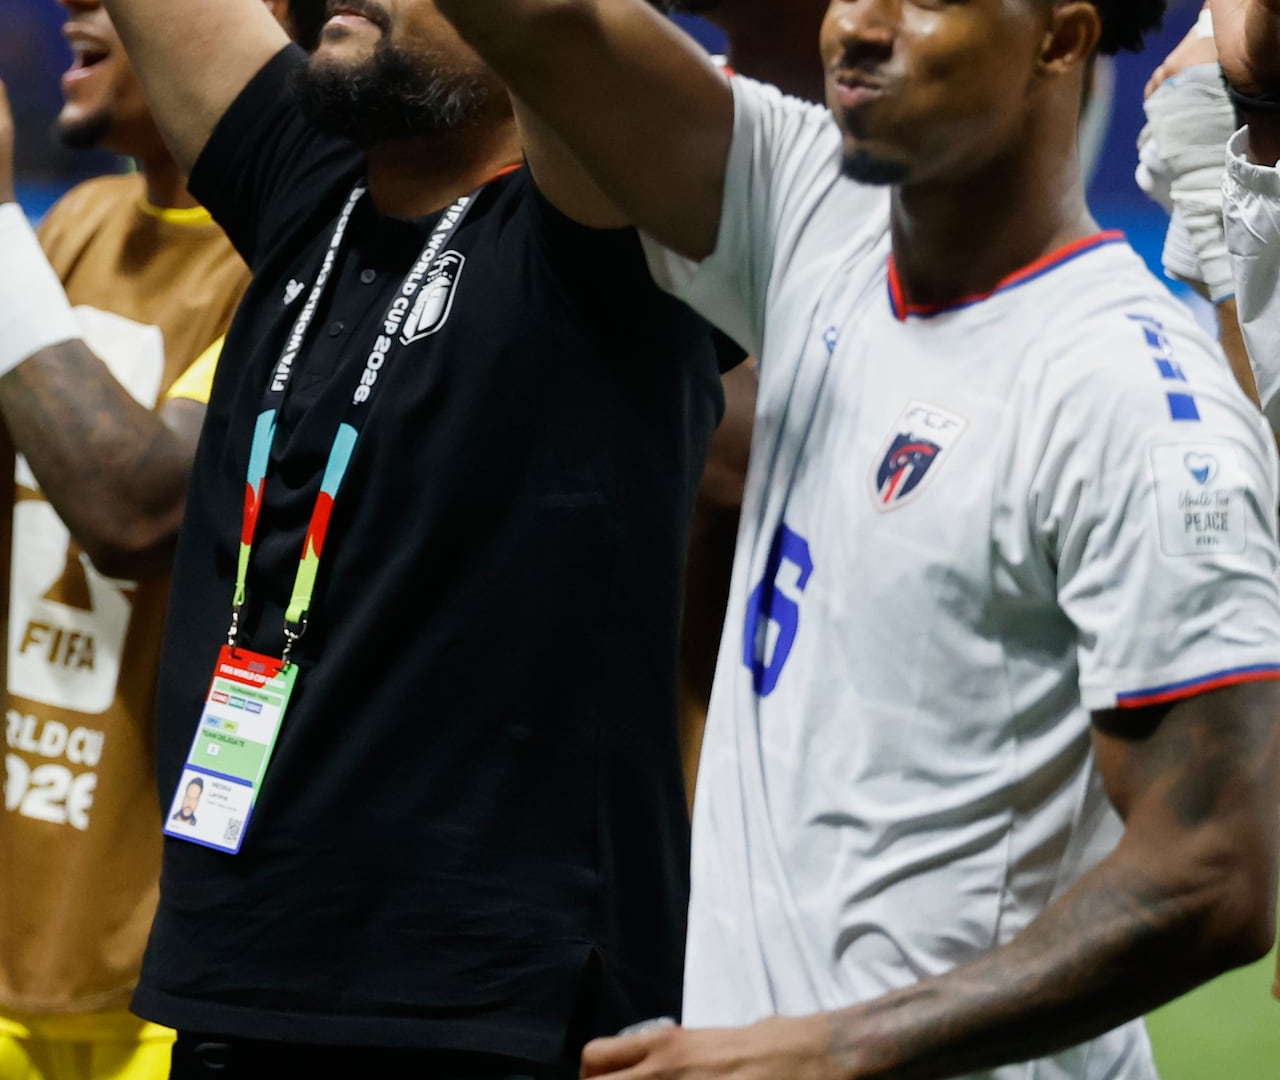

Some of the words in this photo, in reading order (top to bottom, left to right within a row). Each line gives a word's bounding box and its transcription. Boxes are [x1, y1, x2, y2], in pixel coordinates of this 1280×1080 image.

[437, 197, 469, 231] FIFA
[403, 229, 446, 295] WORLD
[271, 348, 296, 391] FIFA
[287, 287, 321, 354] WORLD
[317, 250, 334, 285] CUP
[384, 298, 408, 334] CUP
[1184, 511, 1229, 533] PEACE
[743, 522, 814, 697] 6
[19, 620, 96, 673] FIFA
[66, 726, 105, 767] CU
